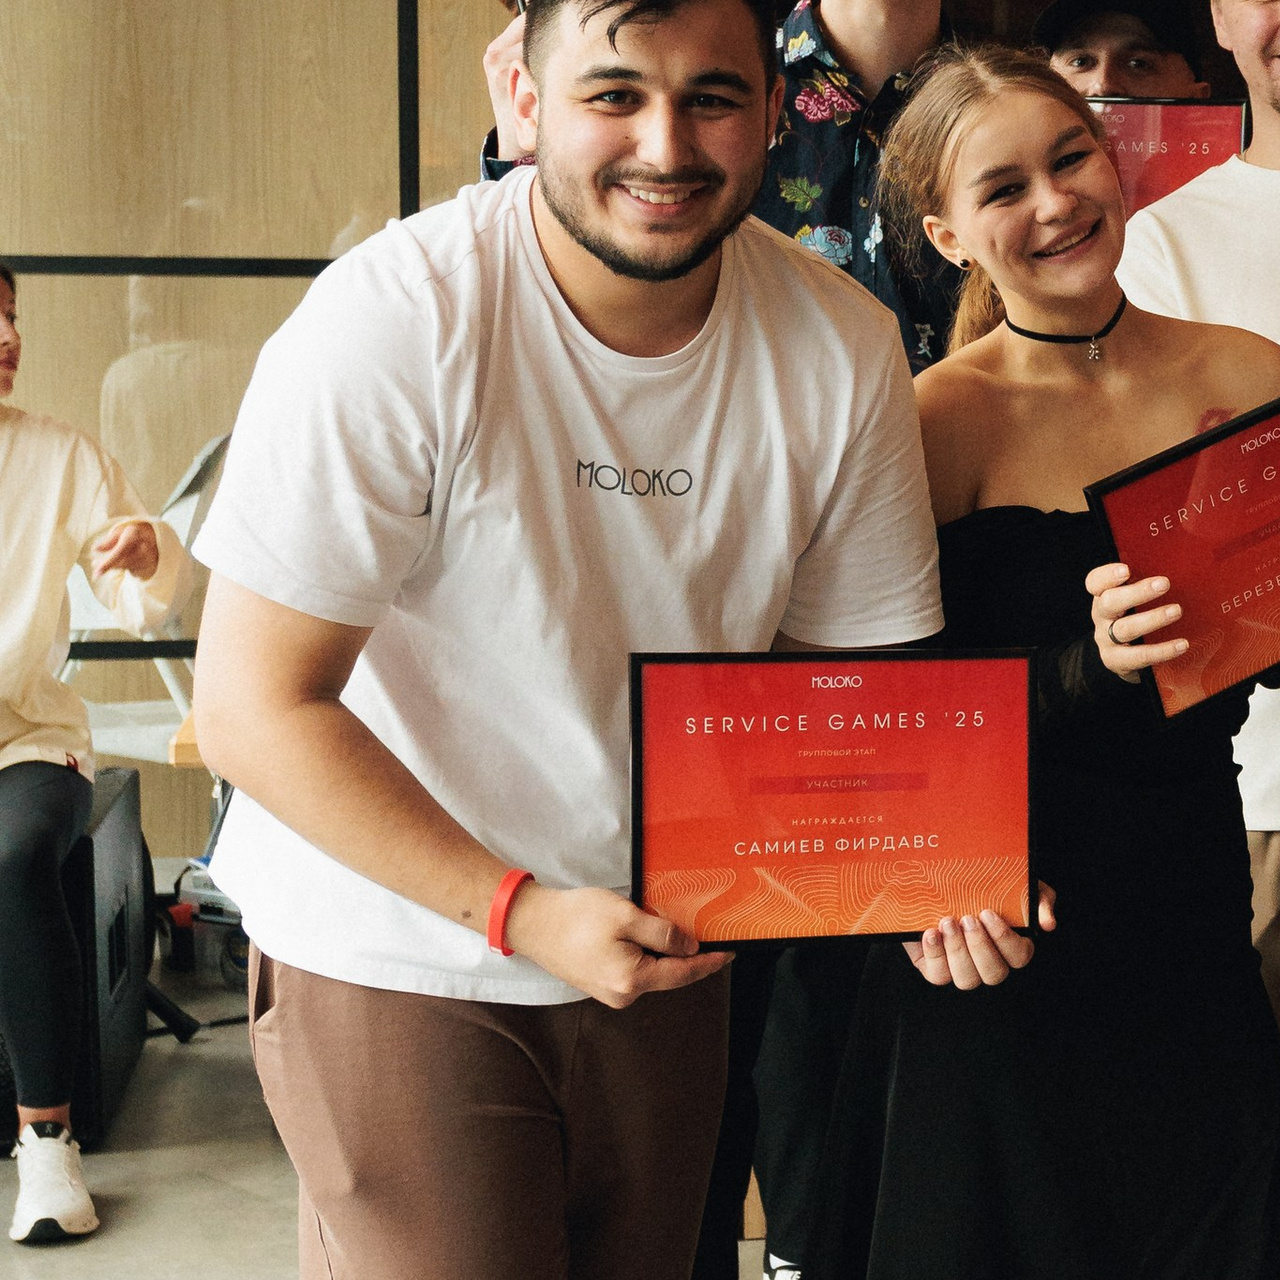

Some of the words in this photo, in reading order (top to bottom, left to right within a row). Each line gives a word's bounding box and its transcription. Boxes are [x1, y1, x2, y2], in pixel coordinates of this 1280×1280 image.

[1103, 140, 1168, 154] GAMES
[1182, 142, 1210, 155] '25
[576, 458, 693, 497] MOLOKO
[1149, 478, 1248, 537] SERVICE
[811, 675, 862, 689] MOLOKO
[685, 715, 808, 734] SERVICE
[828, 712, 926, 731] GAMES
[944, 710, 985, 727] '25
[798, 749, 851, 757] ГРУППОВОЙ
[853, 748, 876, 756] ЭТАП
[806, 778, 868, 789] УЧАСТНИК
[792, 815, 883, 826] НАГРАЖДАЕТСЯ
[735, 839, 825, 856] САМИЕВ
[834, 835, 939, 852] ФИРДАВС
